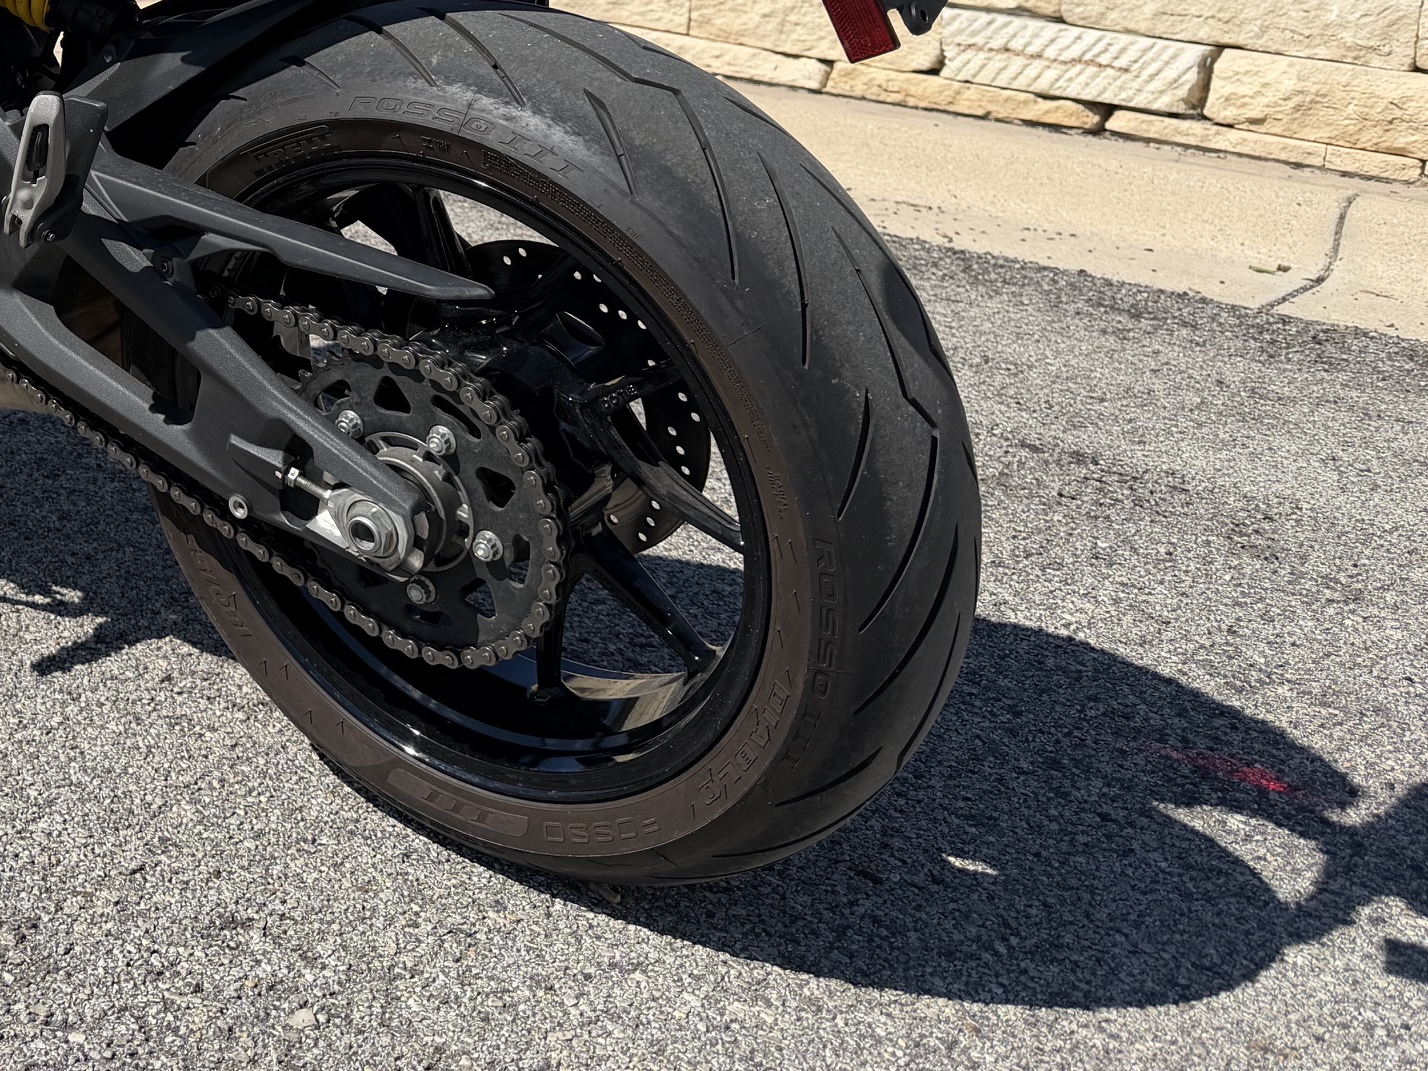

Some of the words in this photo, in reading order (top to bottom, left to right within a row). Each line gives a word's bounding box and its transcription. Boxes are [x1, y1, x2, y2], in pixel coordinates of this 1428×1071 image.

[348, 96, 496, 136] ROSSO
[498, 131, 585, 179] III
[812, 538, 840, 699] ROSSO
[780, 705, 824, 771] III
